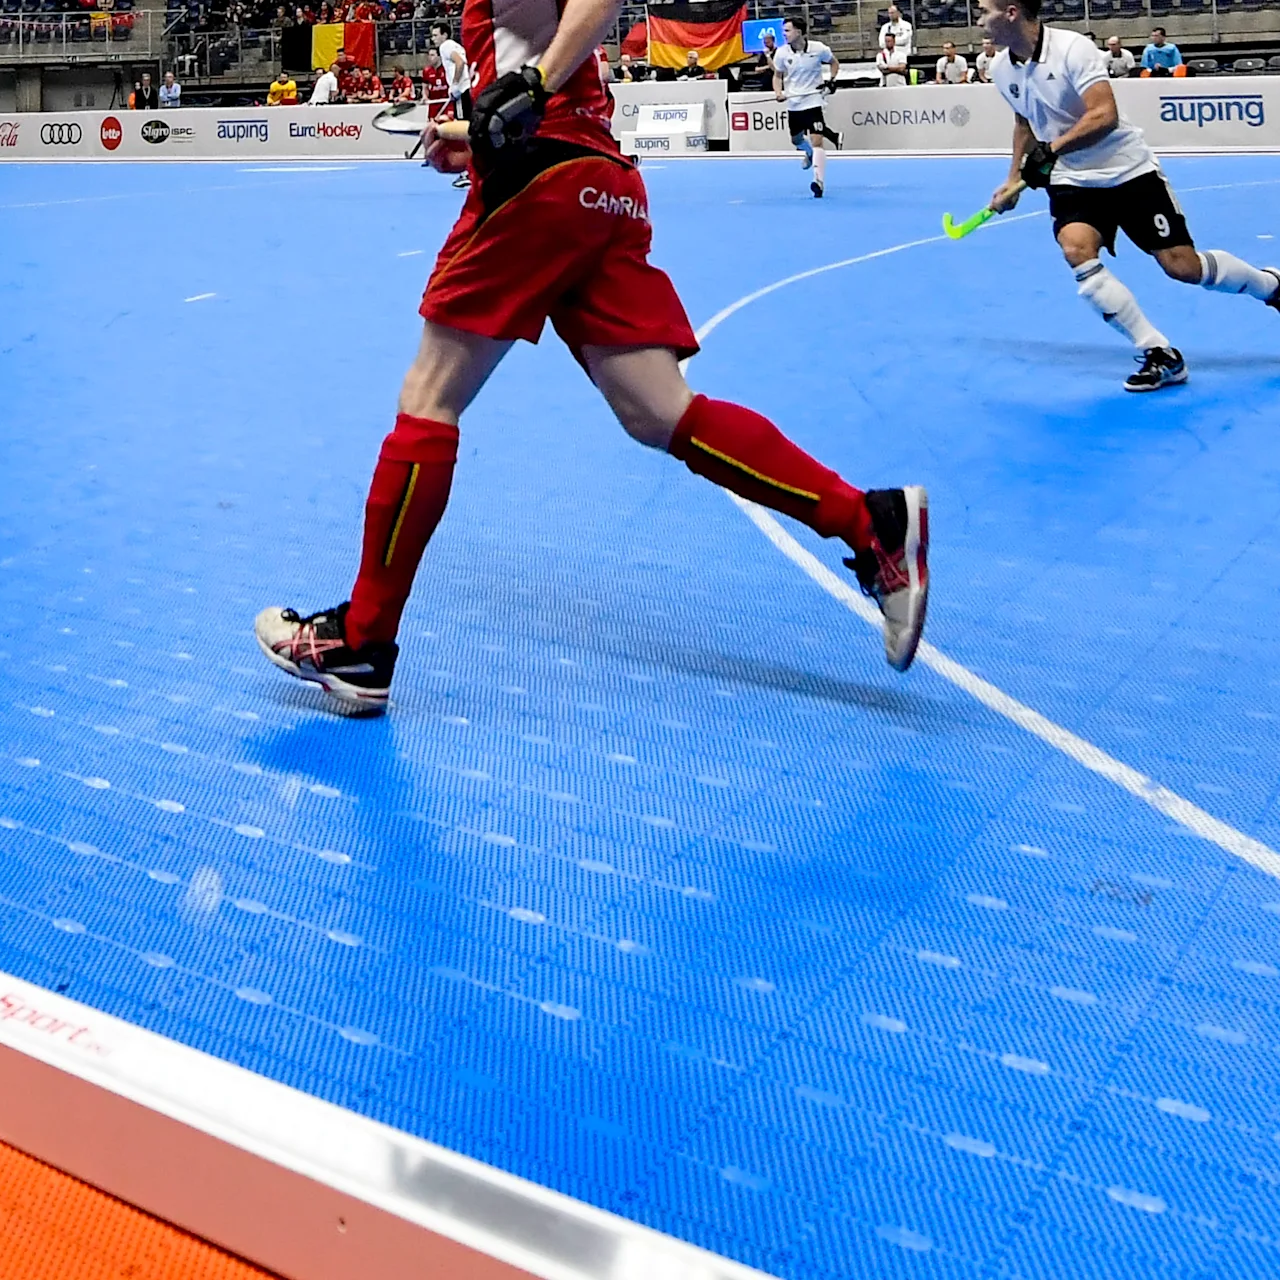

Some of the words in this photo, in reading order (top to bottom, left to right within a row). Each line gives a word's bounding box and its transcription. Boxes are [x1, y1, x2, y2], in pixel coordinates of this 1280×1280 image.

[652, 110, 688, 121] auping
[852, 110, 946, 126] CANDRIAM
[1160, 94, 1265, 128] auping
[217, 120, 269, 142] auping
[753, 112, 788, 131] Belf
[141, 123, 170, 140] Sligro
[289, 122, 363, 141] EuroHockey
[634, 137, 670, 150] auping
[1153, 213, 1170, 238] 9
